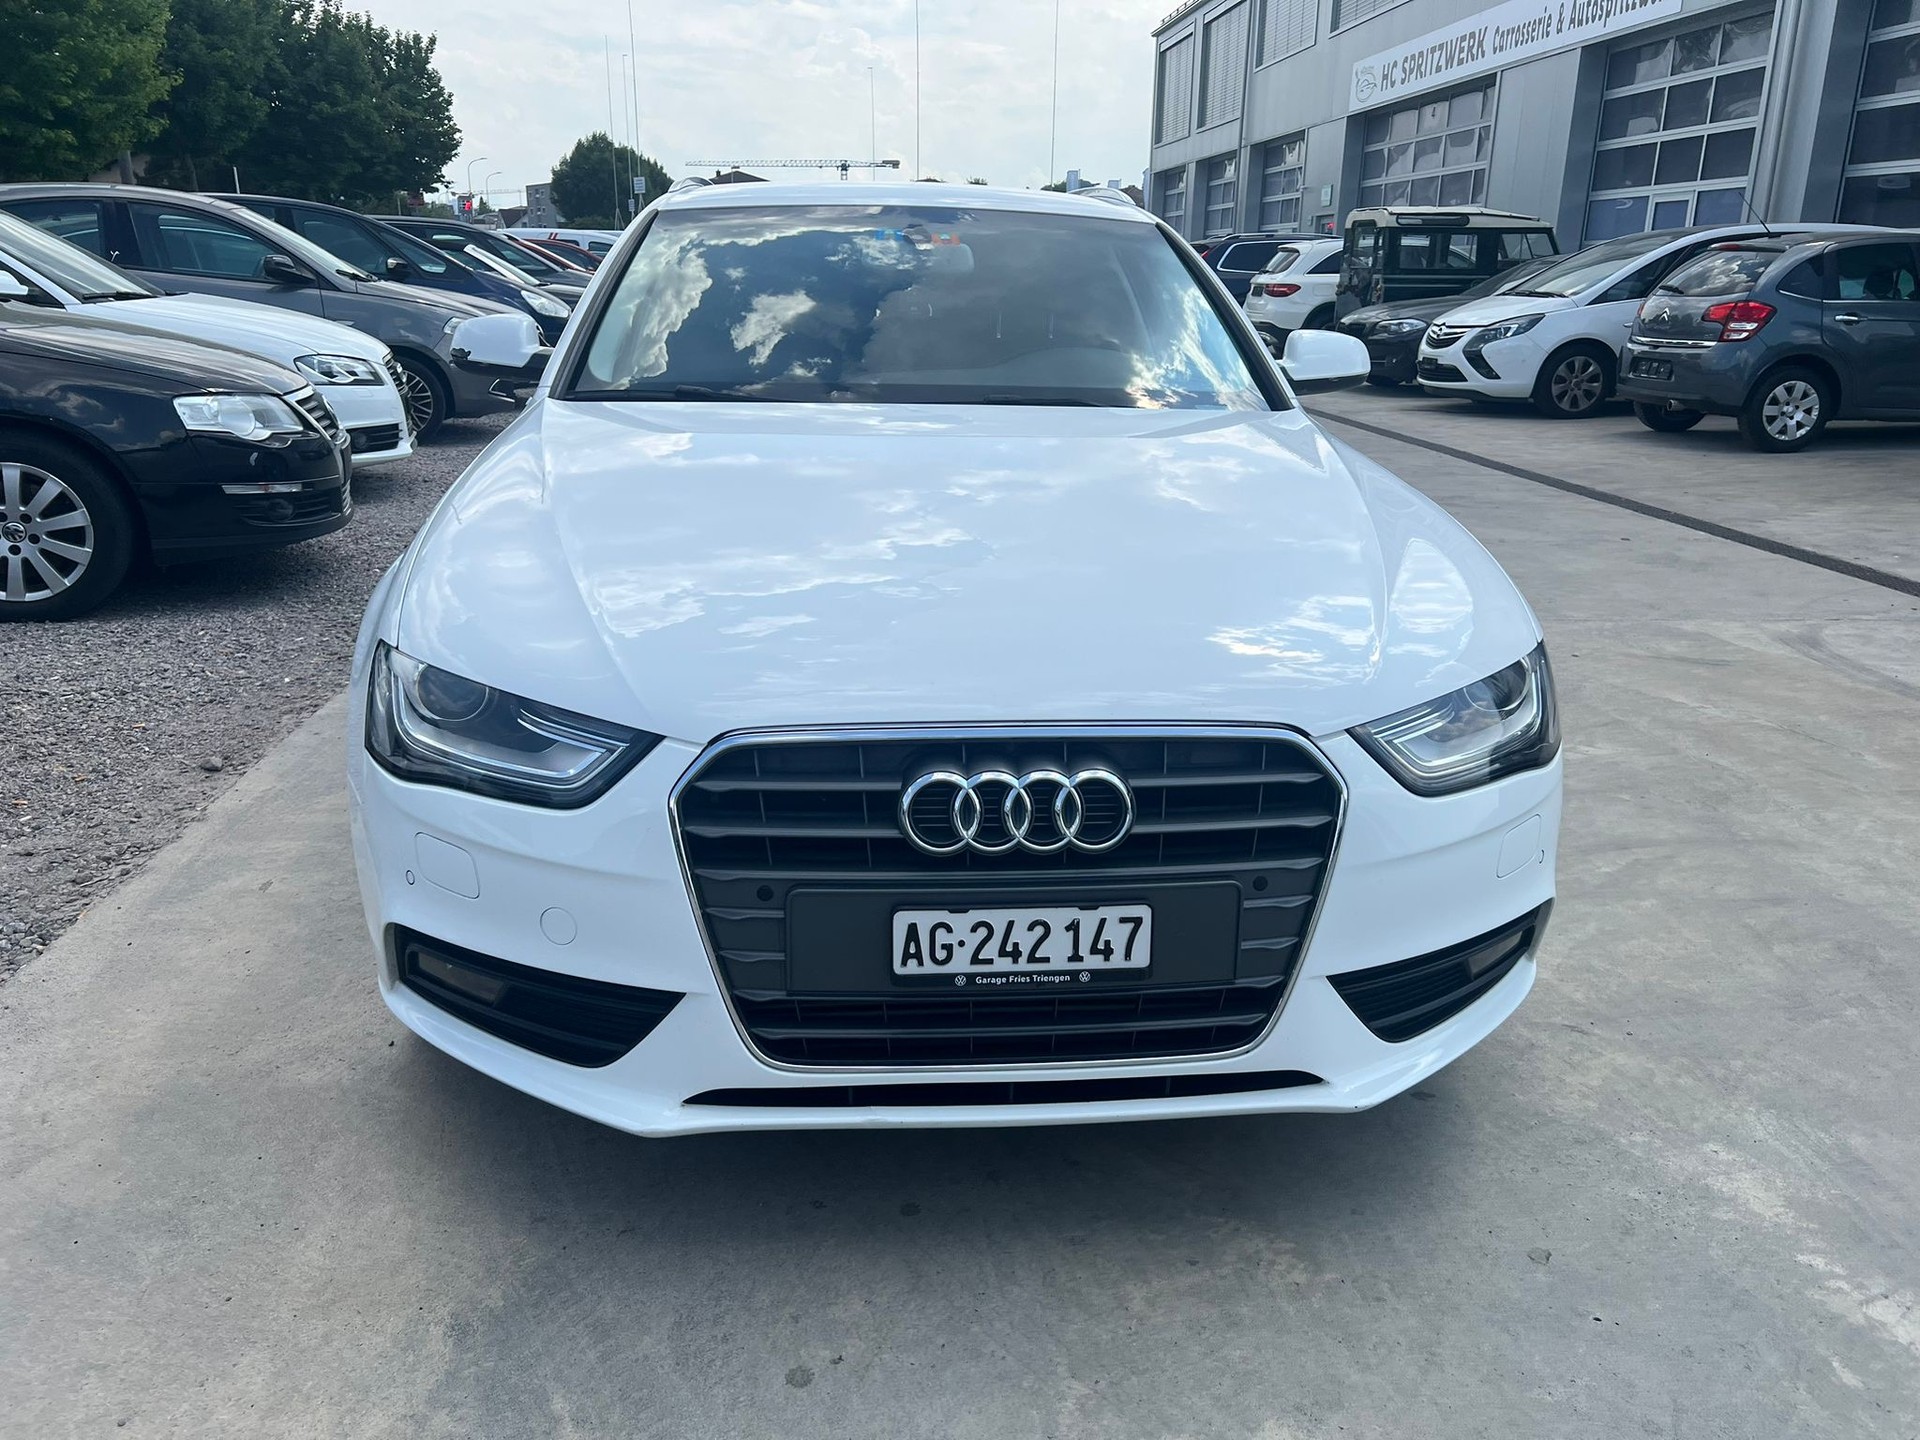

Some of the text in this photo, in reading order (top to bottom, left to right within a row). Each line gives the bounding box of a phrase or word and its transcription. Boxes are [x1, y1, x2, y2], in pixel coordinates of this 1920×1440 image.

[1380, 60, 1398, 92] HC
[1401, 25, 1487, 86] SPRITZWERK
[1492, 6, 1552, 56] Carrosserie
[1556, 2, 1565, 35] &
[975, 976, 1007, 985] Garage
[1009, 975, 1031, 984] Fries
[1032, 974, 1071, 984] Triengen
